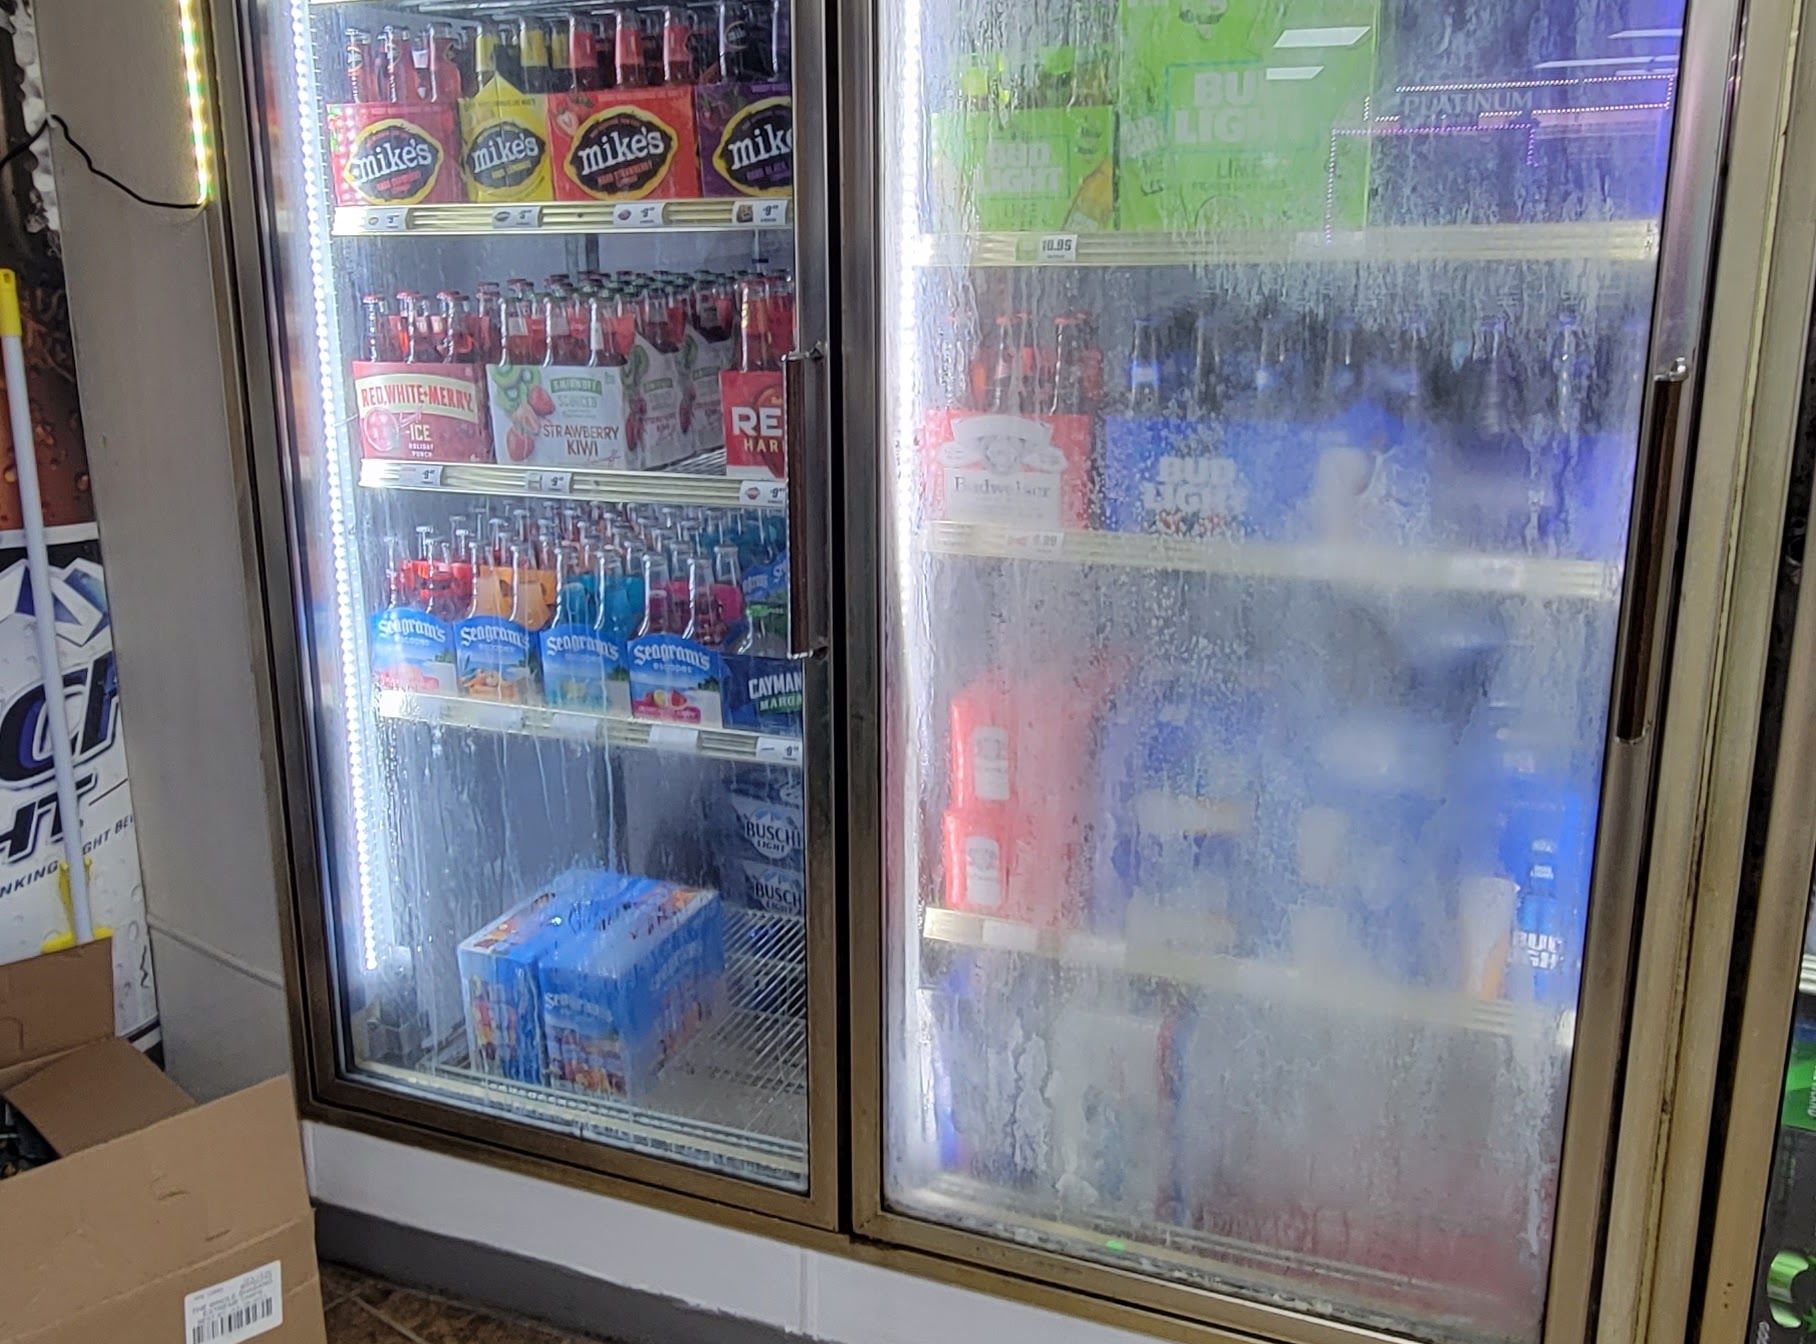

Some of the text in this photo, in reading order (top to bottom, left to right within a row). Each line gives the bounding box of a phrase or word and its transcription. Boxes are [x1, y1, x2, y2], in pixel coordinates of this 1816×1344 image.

[1404, 90, 1534, 116] PLATINUM
[355, 138, 433, 183] mike's
[471, 133, 539, 174] mike's
[578, 126, 665, 175] mike's
[384, 384, 424, 405] WHITE
[428, 385, 476, 413] MERRY
[409, 424, 432, 441] ICE
[543, 424, 620, 441] STRAWBERRY
[567, 439, 599, 457] KIWI
[377, 618, 447, 643] Seagram's
[460, 624, 530, 649] Seagram's
[546, 634, 620, 662] Seagram's
[633, 643, 710, 671] Seagram's
[757, 839, 785, 853] LIGHT
